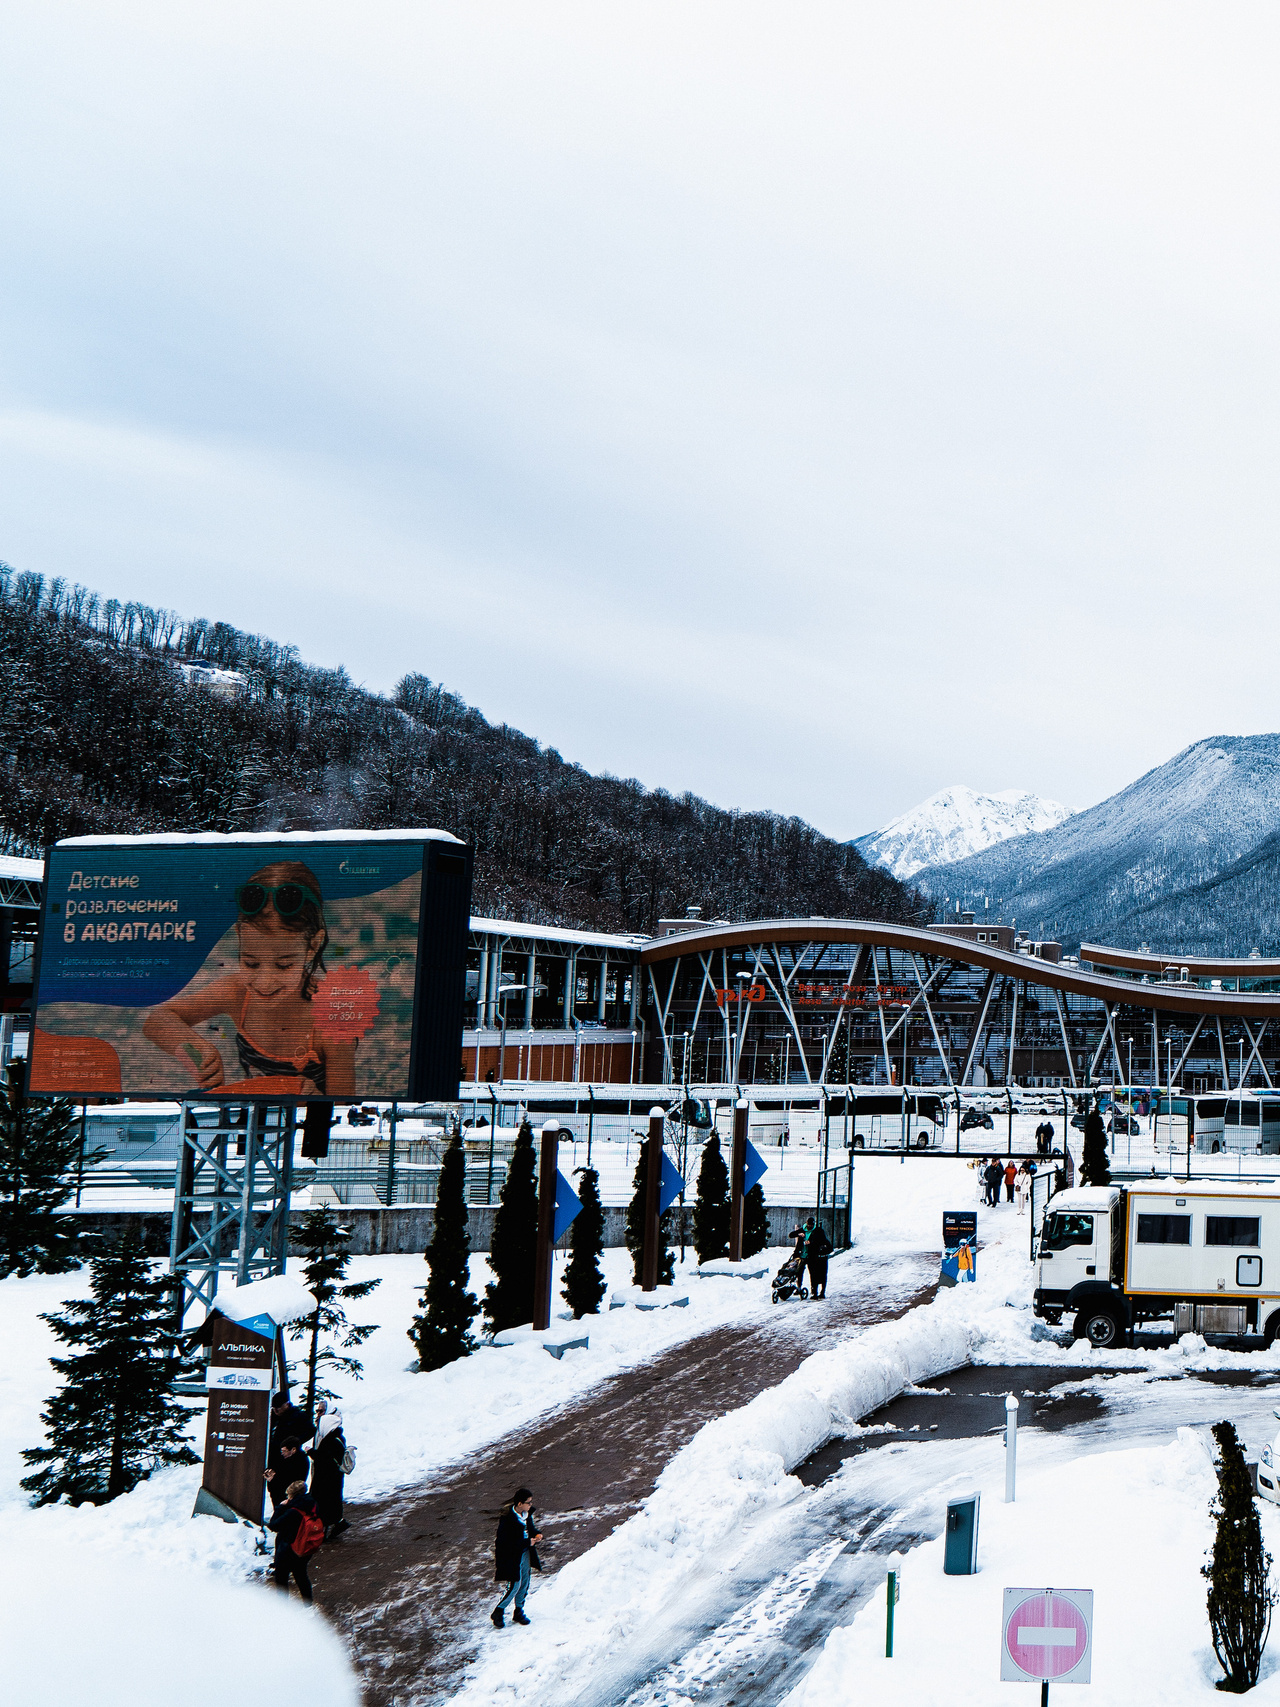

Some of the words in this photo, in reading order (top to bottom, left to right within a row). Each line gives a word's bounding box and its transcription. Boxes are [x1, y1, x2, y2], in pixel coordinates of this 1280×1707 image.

[68, 871, 139, 892] Детские
[66, 899, 178, 919] развлечения
[64, 923, 76, 943] В
[81, 920, 197, 943] АКВАПАРКЕ
[330, 986, 364, 996] Детский
[843, 984, 867, 992] Роза
[876, 984, 908, 994] Хутор
[832, 997, 867, 1005] Khutor
[217, 1343, 266, 1353] АЛЬПИКА
[220, 1401, 230, 1409] До
